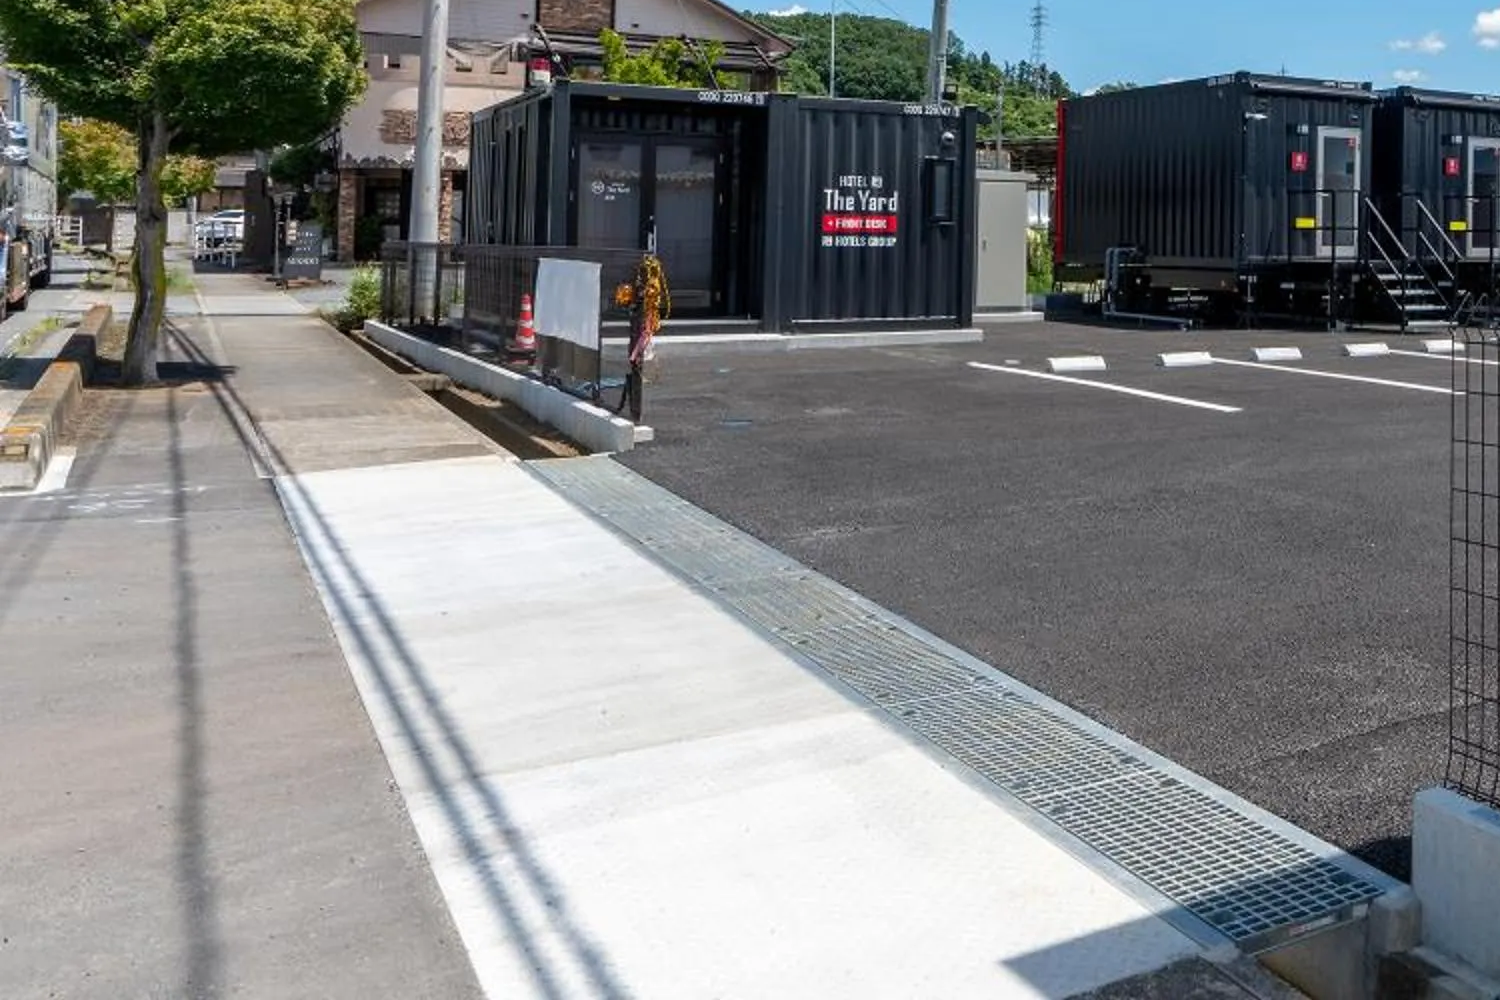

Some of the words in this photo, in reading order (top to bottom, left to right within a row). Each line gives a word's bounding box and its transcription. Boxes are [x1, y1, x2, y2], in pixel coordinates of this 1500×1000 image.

[839, 175, 868, 187] HOTEL
[823, 188, 856, 211] The
[857, 189, 899, 212] Yard
[835, 235, 867, 247] HOTELS
